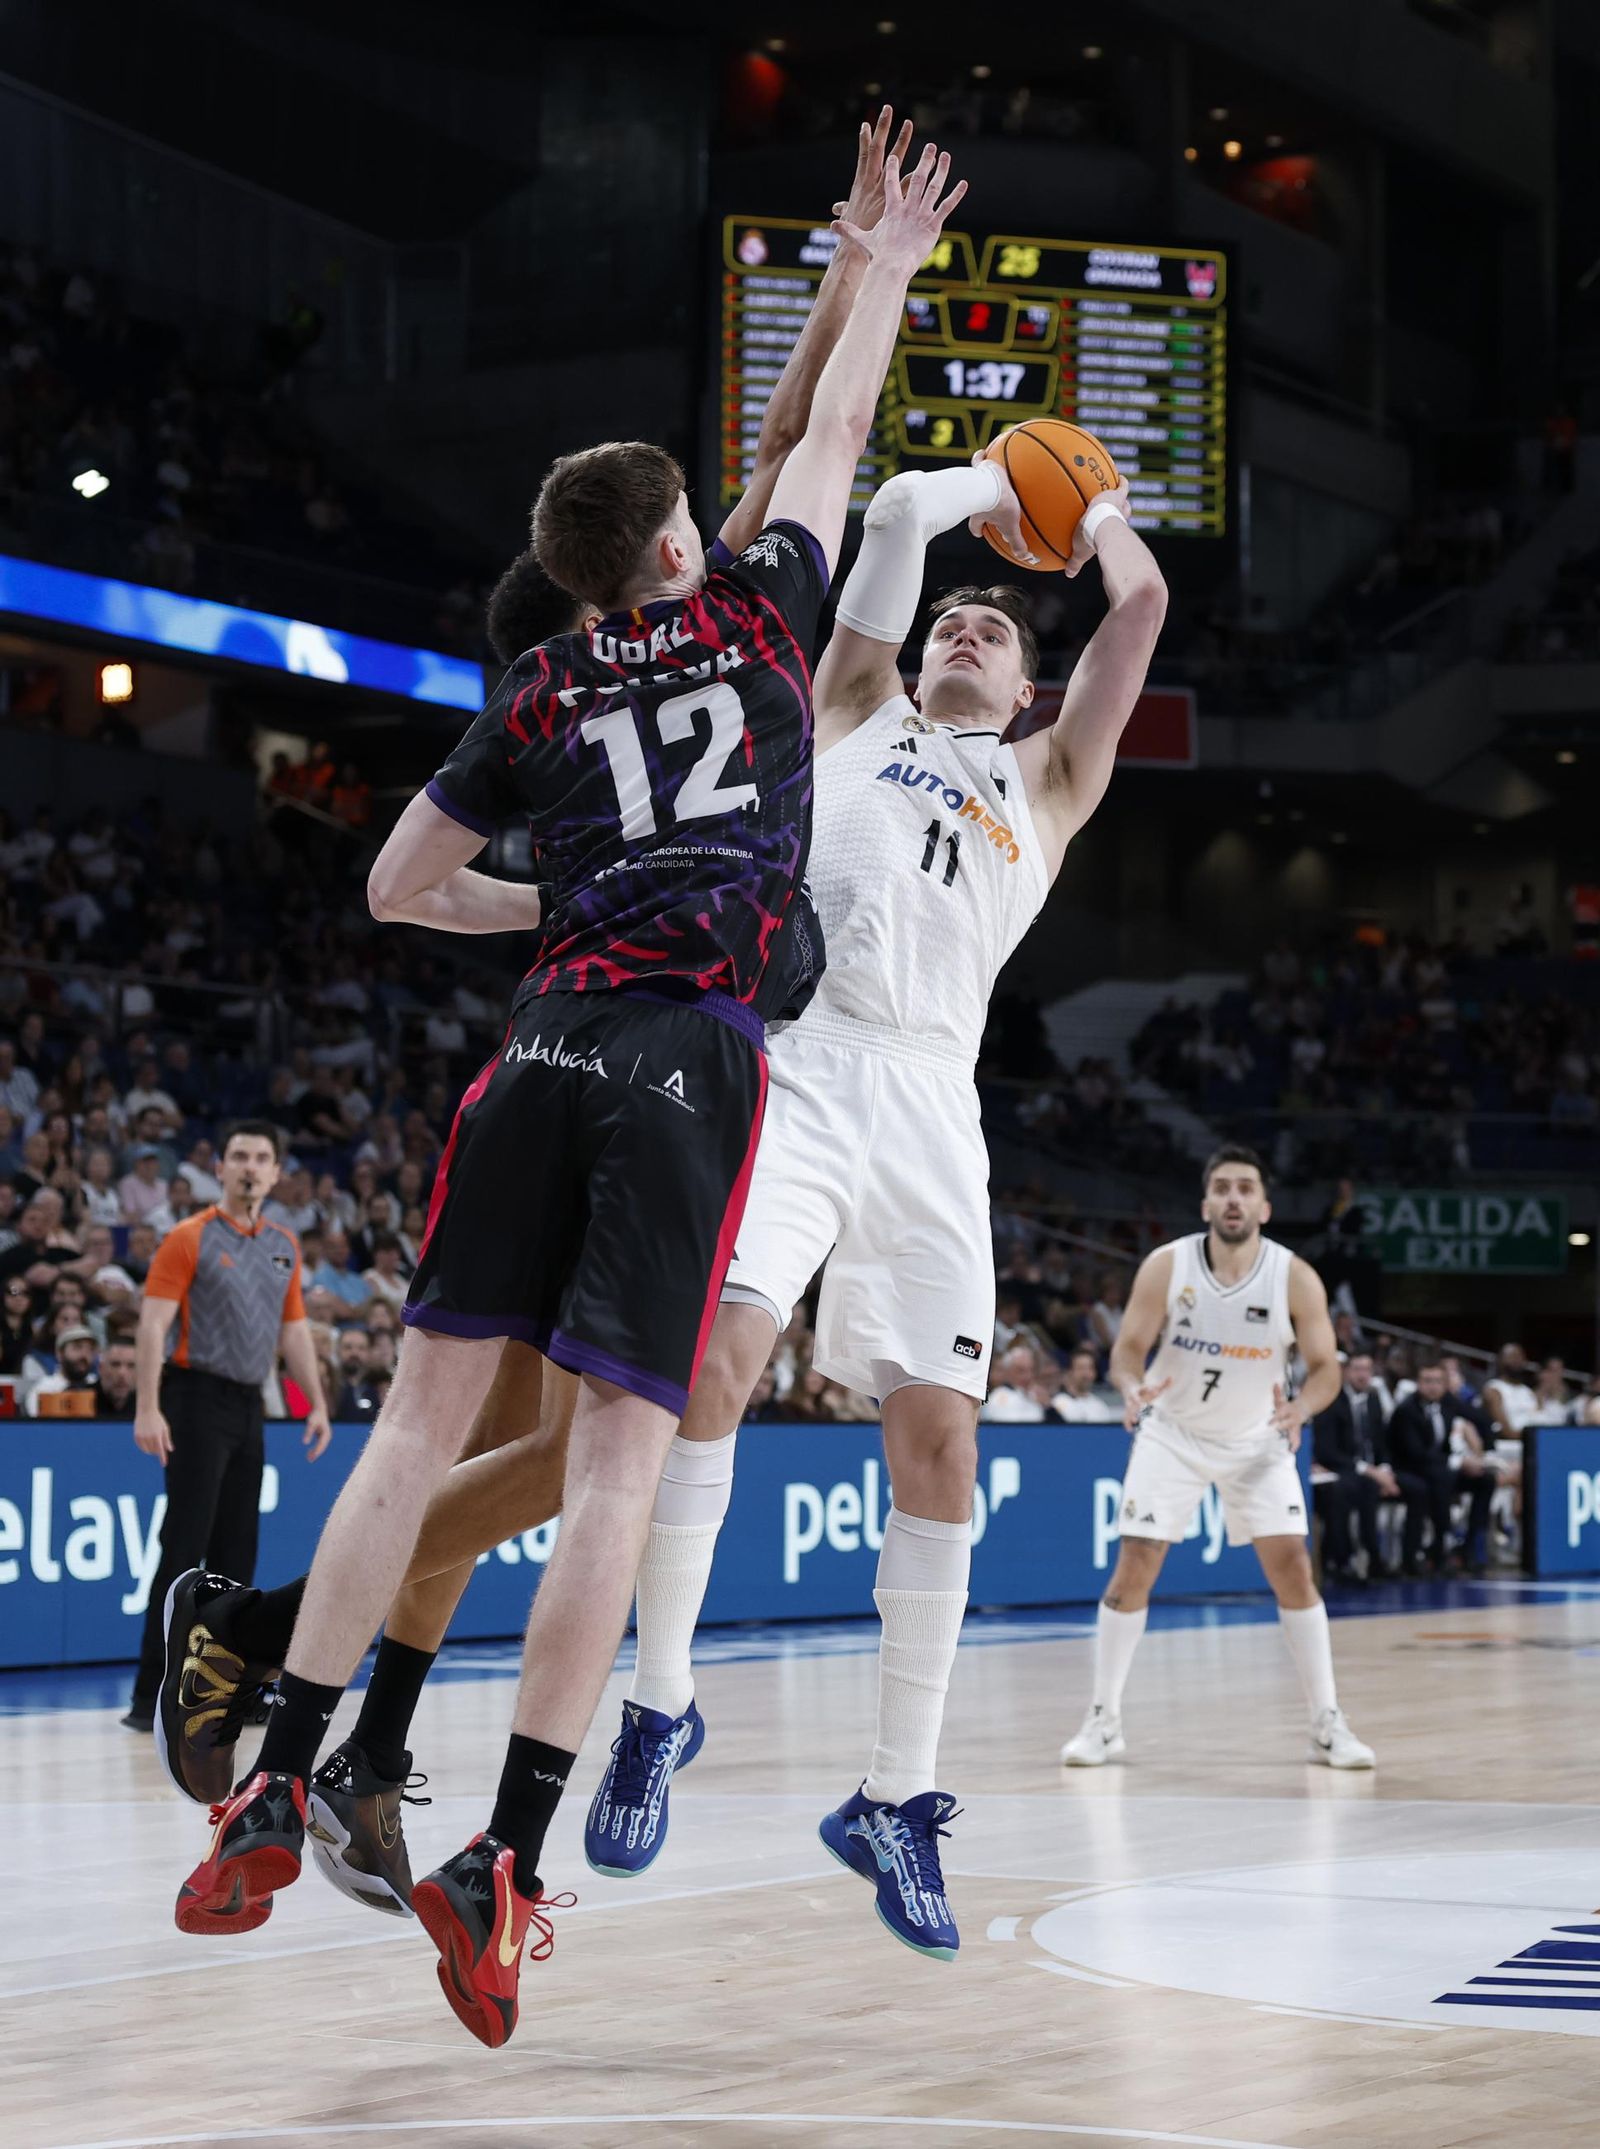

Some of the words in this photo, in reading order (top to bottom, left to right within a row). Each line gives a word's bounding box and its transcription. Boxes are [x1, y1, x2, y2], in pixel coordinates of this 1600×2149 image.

[943, 359, 1026, 400] 1:37
[580, 682, 759, 842] 12
[876, 762, 1020, 865] AUTOHERO
[645, 859, 695, 869] CANDIDATA
[649, 846, 690, 857] UROPEA
[691, 846, 703, 855] DE
[705, 846, 717, 855] LA
[717, 847, 754, 860] CULTURA
[920, 818, 964, 888] 11
[505, 1033, 609, 1079] ndalucía
[1357, 1194, 1552, 1238] SALIDA
[1405, 1236, 1498, 1268] EXIT
[955, 1343, 977, 1358] acb
[1172, 1334, 1273, 1360] AUTOHERO
[1203, 1368, 1224, 1402] 7
